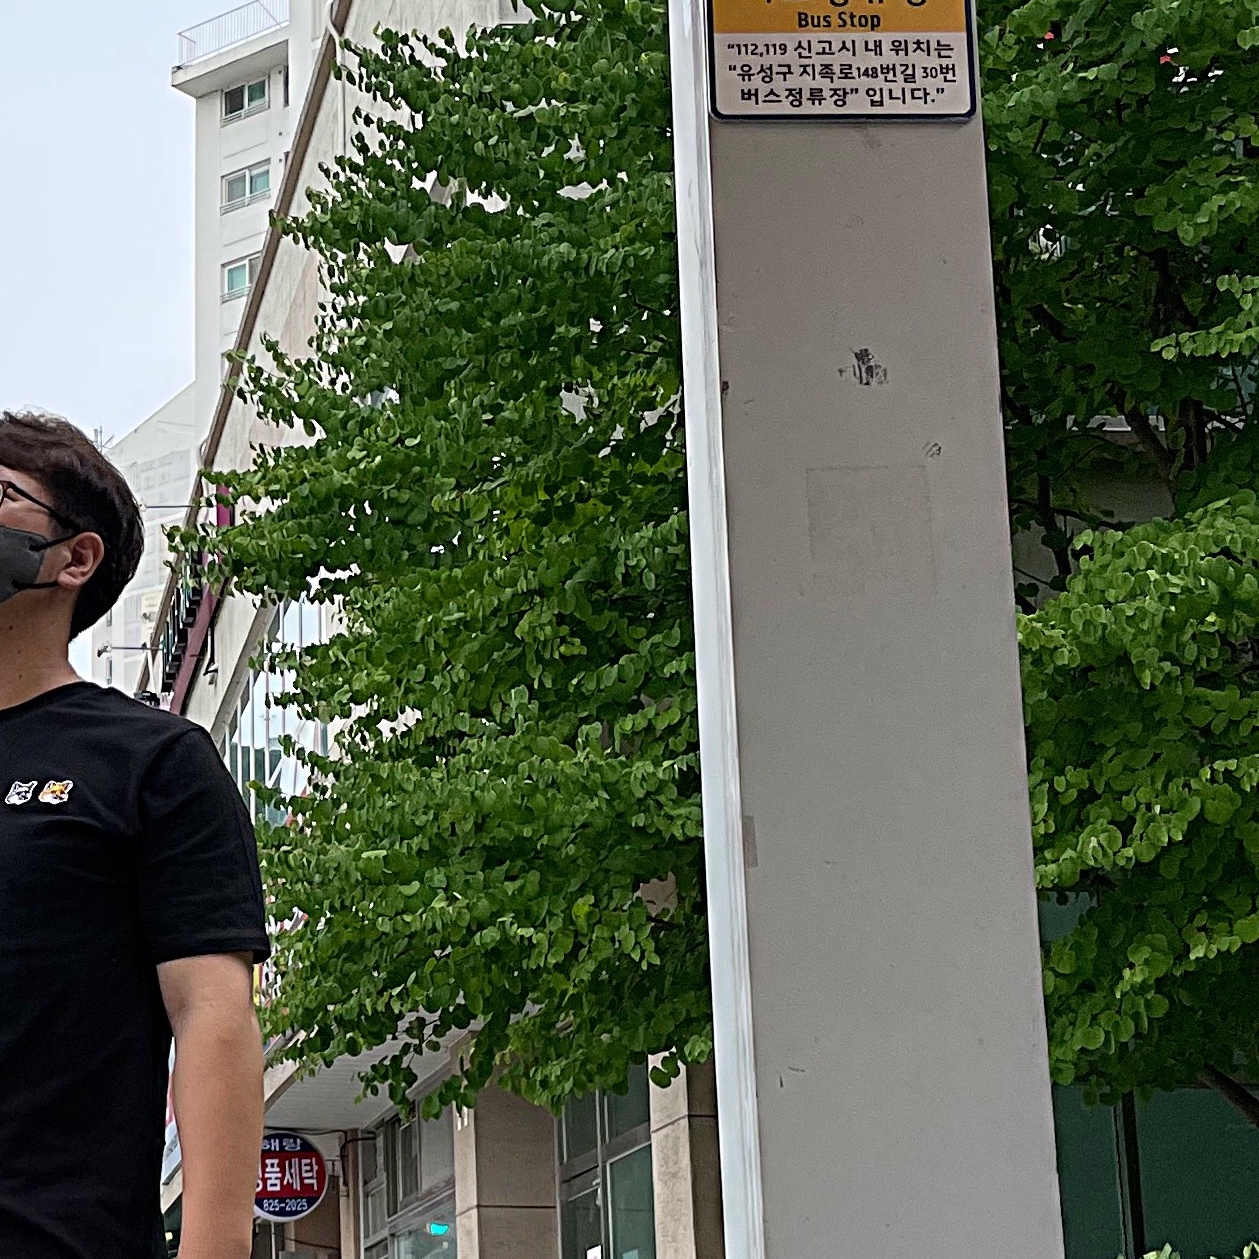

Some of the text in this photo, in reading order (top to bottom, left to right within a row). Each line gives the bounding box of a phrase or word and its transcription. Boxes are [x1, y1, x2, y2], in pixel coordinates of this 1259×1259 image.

[797, 11, 882, 32] Bus Stop
[793, 39, 857, 59] 신고시
[864, 39, 883, 58] 내
[889, 39, 955, 60] 위치는
[921, 63, 957, 84] 30번
[262, 1199, 309, 1212] 825-2025
